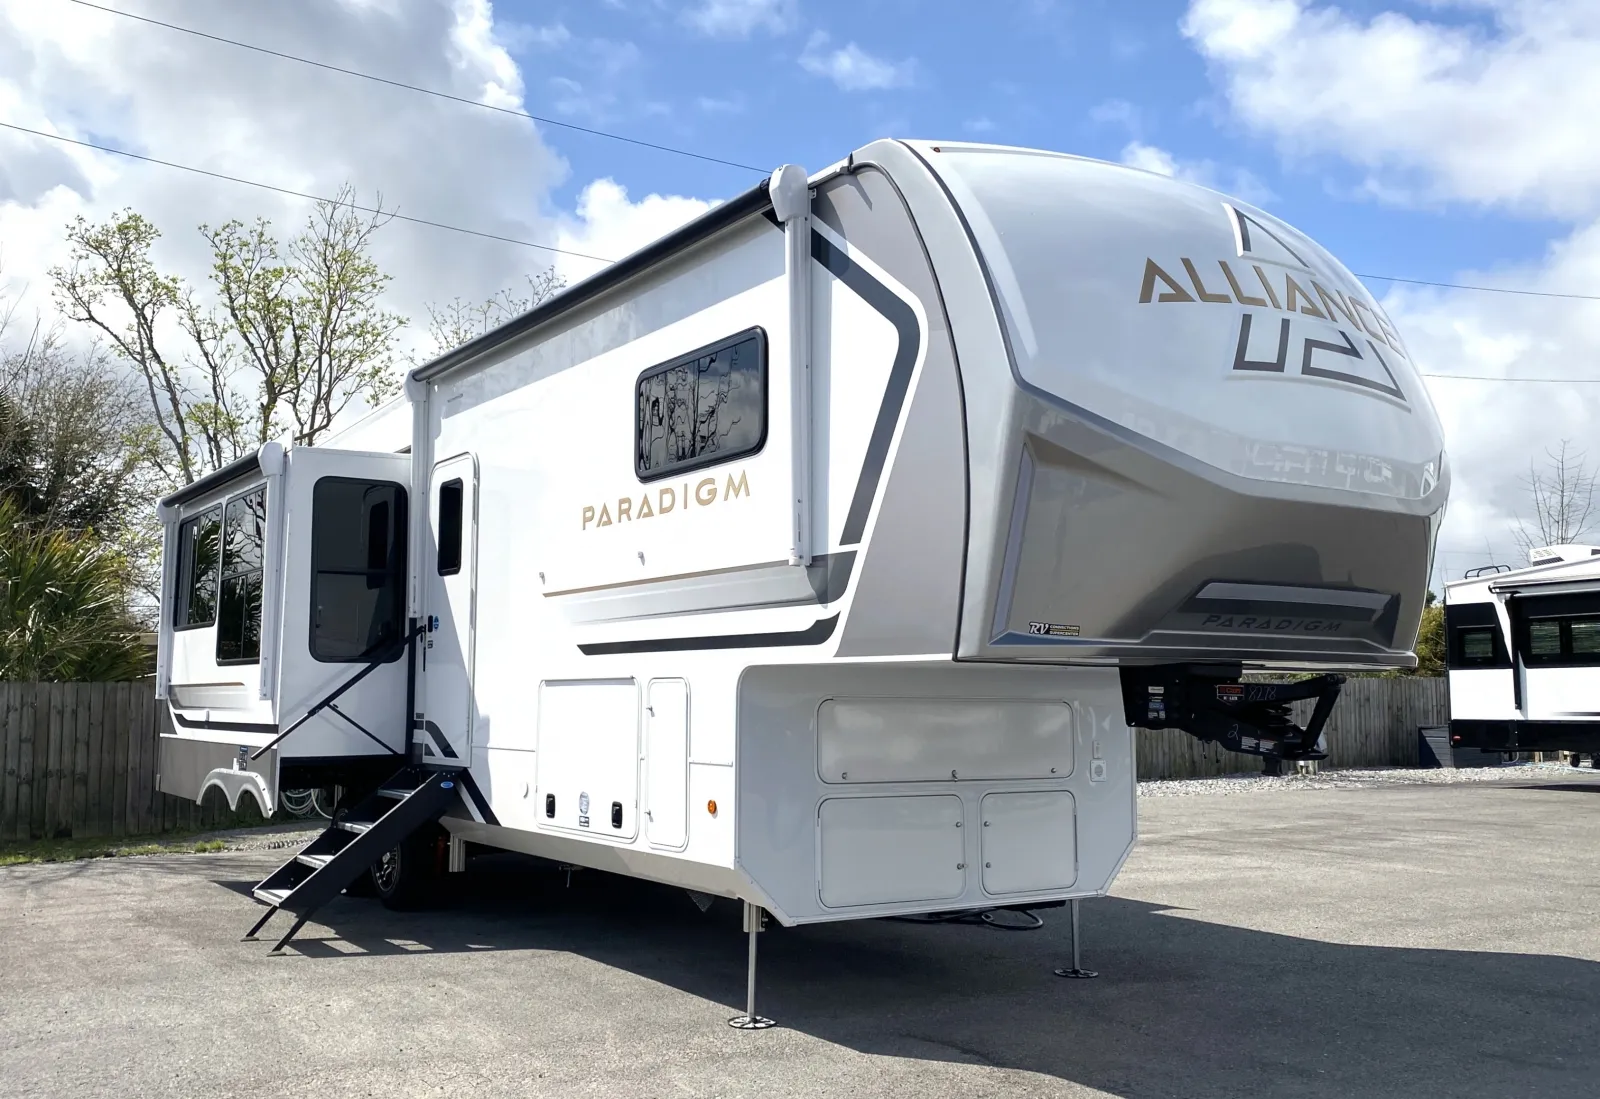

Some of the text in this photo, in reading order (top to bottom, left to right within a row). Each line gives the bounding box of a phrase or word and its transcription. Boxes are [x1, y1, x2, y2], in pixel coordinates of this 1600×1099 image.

[1138, 257, 1406, 359] ALLIANCE
[582, 469, 750, 530] PARADIGM
[1029, 622, 1049, 634] RV
[1202, 615, 1342, 632] PARADIGM
